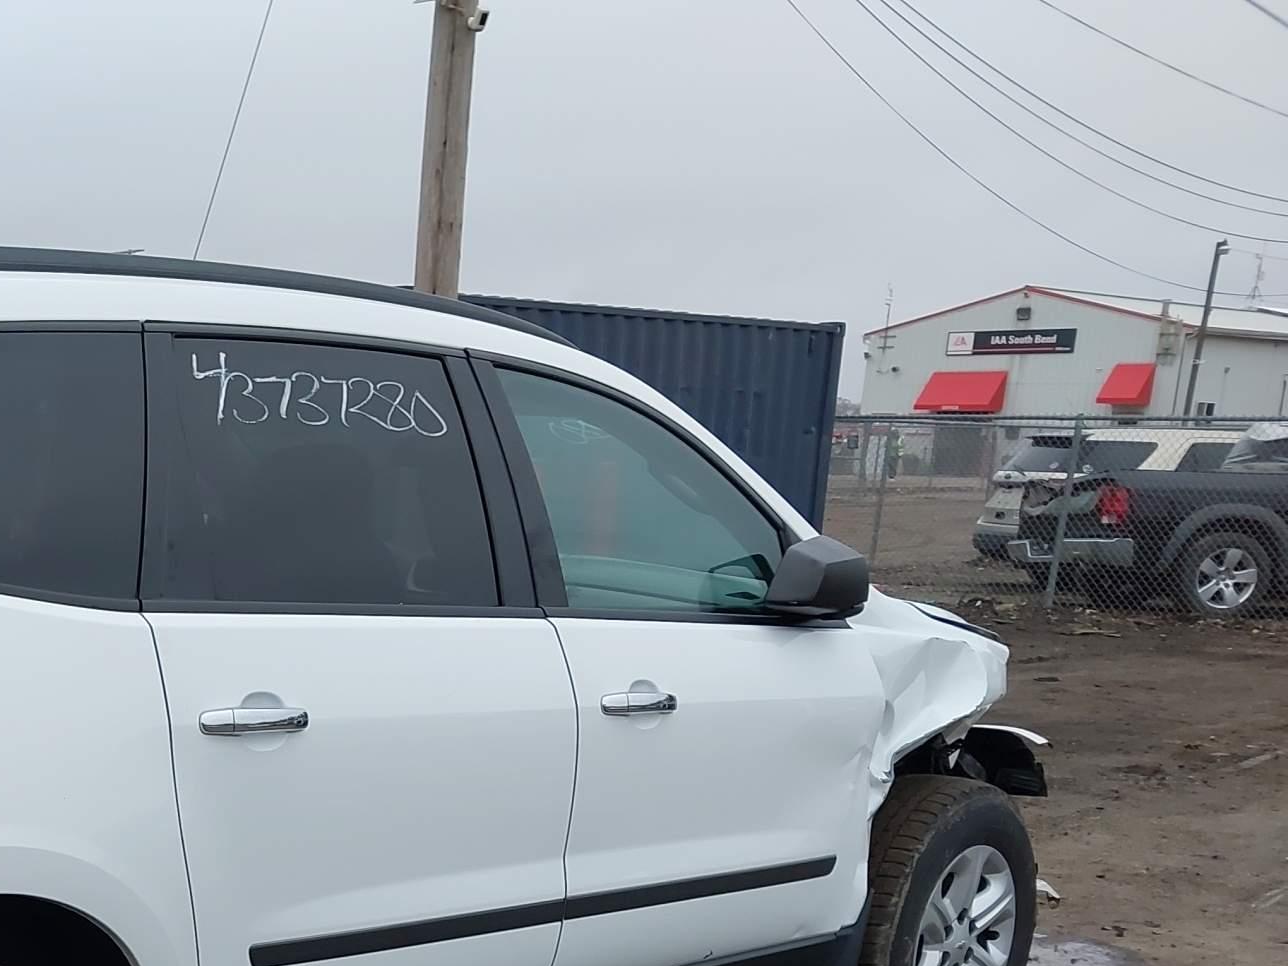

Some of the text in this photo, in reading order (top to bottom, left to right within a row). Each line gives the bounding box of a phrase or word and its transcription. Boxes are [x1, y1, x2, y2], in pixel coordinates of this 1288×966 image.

[990, 334, 1057, 345] IAA South Bend
[192, 352, 448, 436] 43737280
